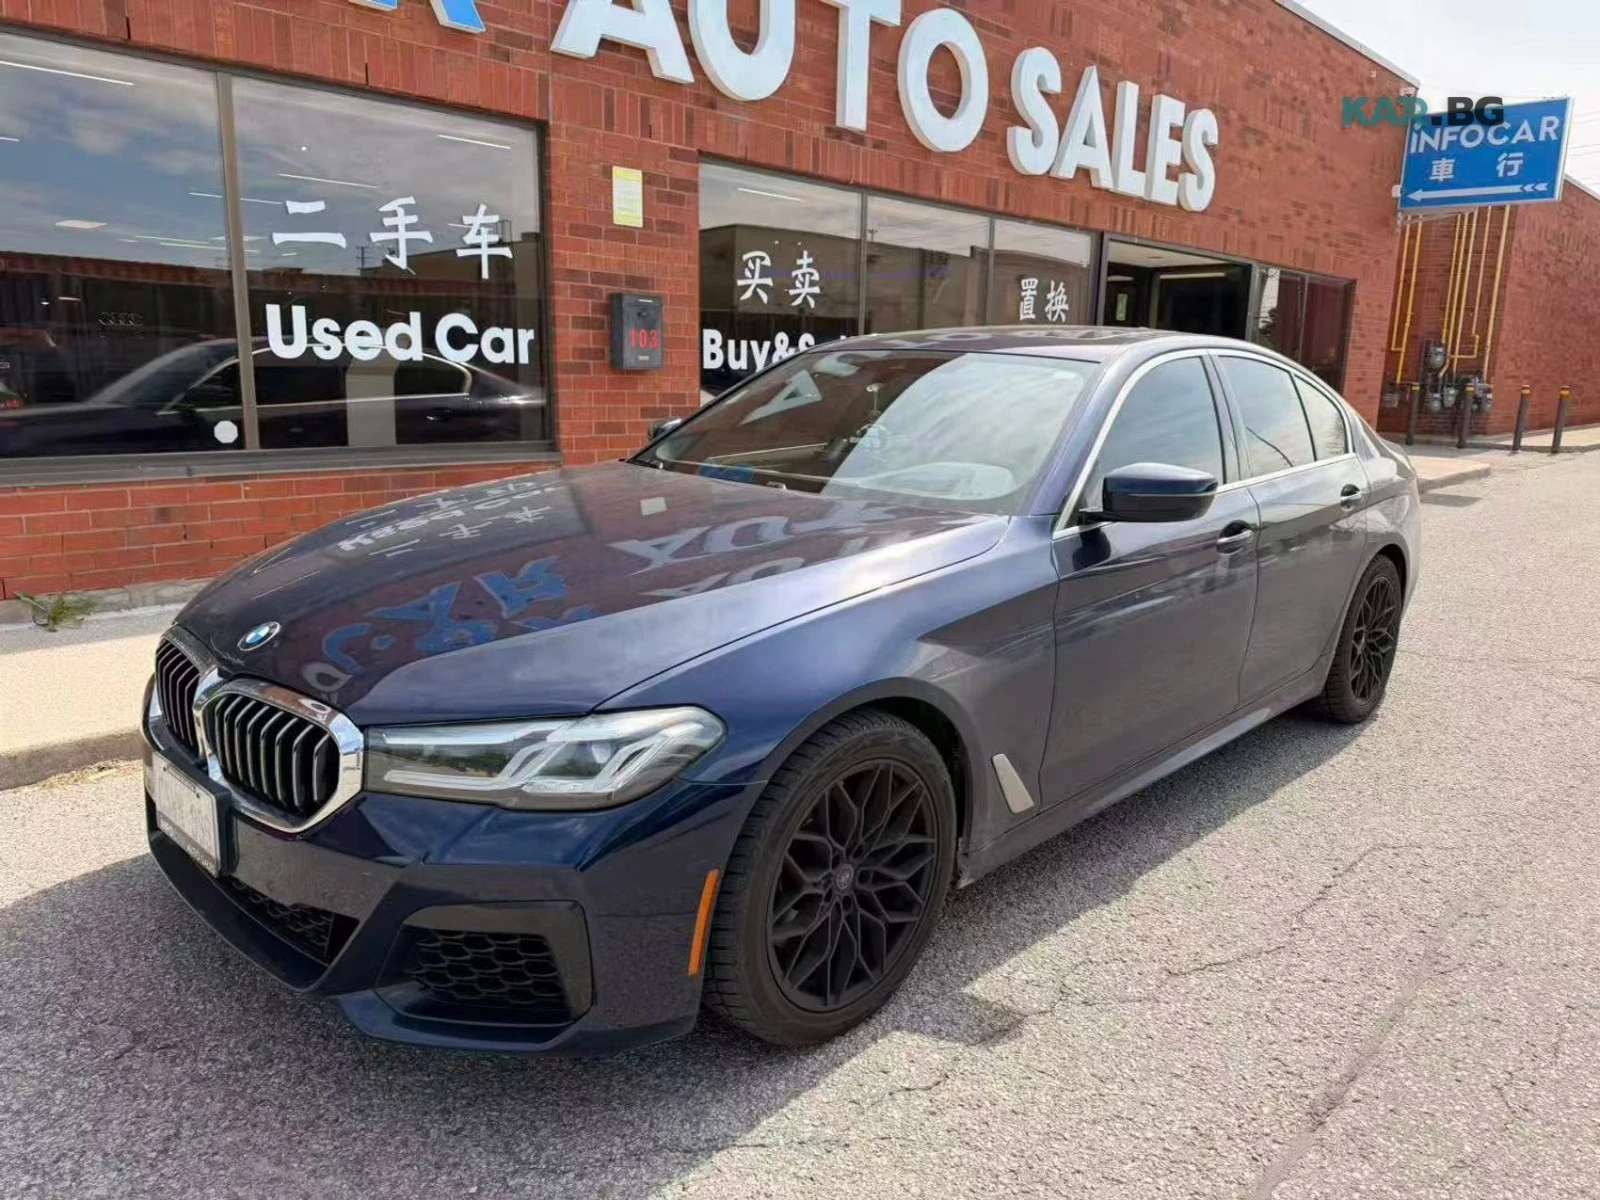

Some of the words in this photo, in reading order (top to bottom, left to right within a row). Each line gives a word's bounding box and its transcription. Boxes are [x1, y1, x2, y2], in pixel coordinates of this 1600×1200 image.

[1007, 46, 1219, 212] SALES
[1429, 152, 1524, 182] 車行
[272, 196, 513, 279] 二手车
[737, 250, 821, 308] 买卖
[1020, 278, 1069, 323] 置换
[266, 303, 423, 361] Used
[435, 313, 535, 364] Car
[629, 328, 659, 349] 103
